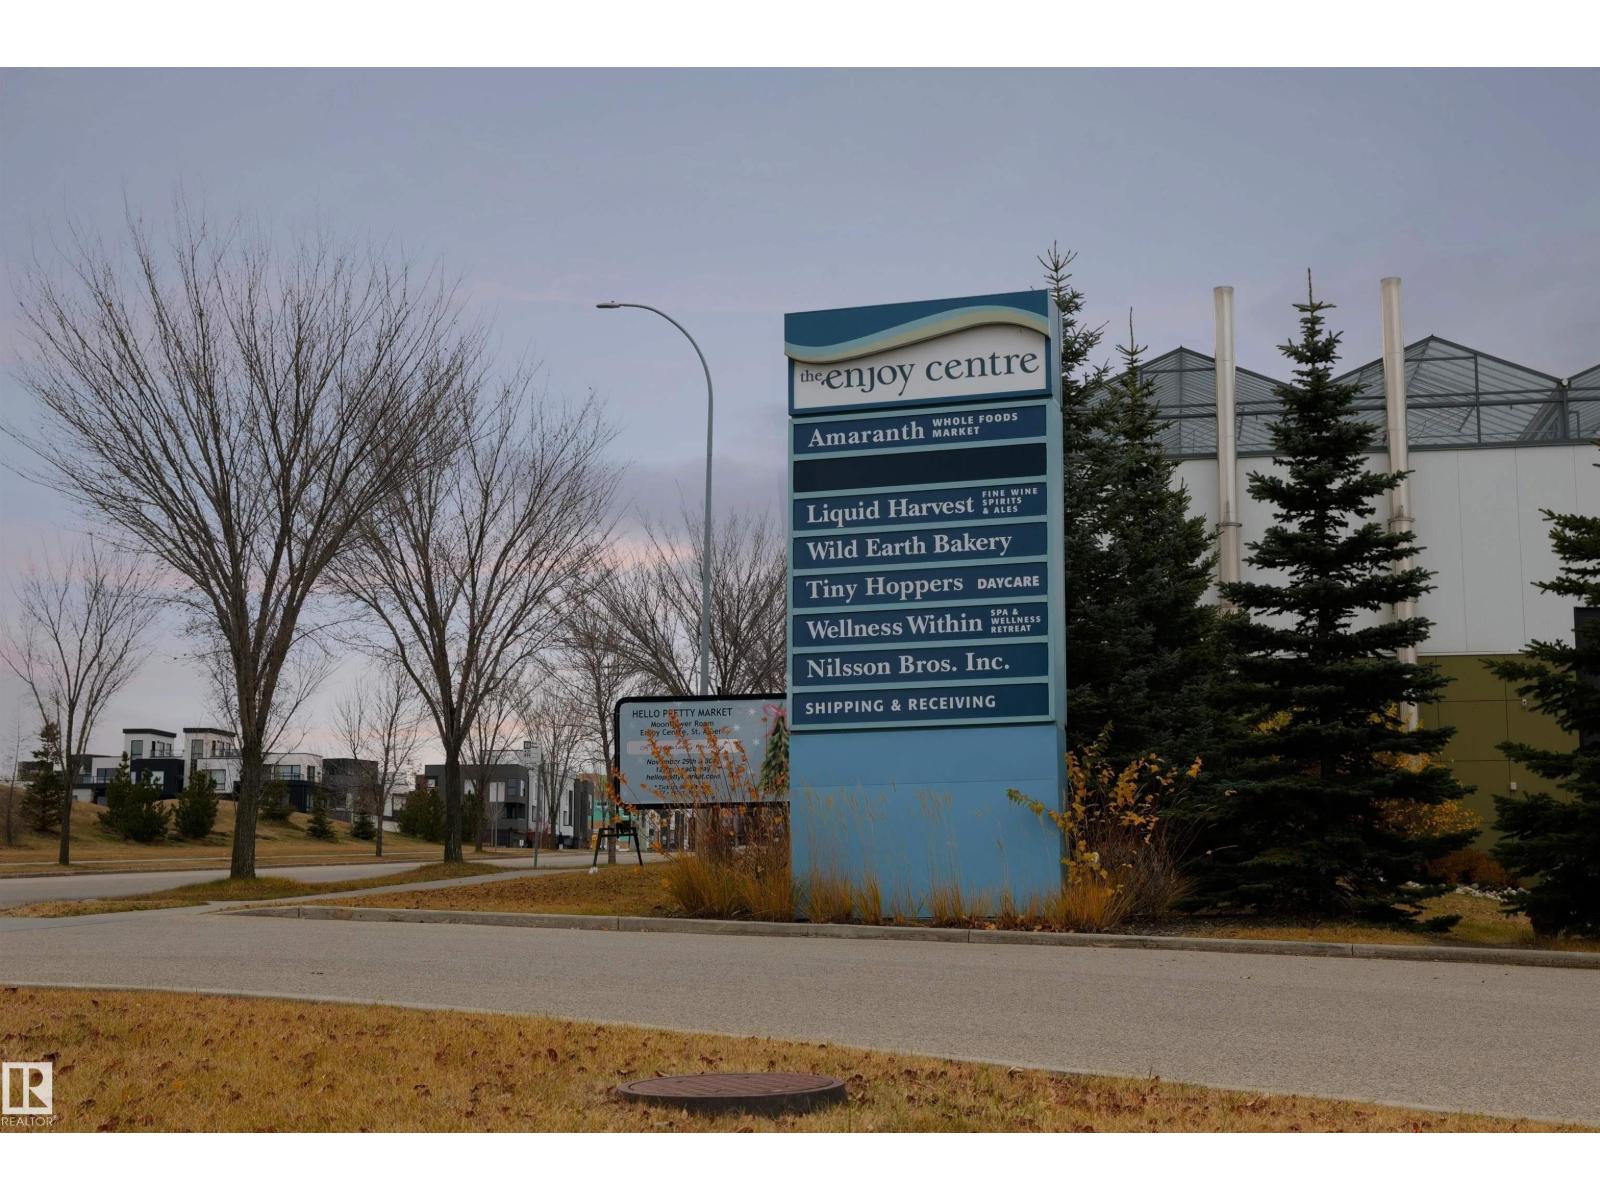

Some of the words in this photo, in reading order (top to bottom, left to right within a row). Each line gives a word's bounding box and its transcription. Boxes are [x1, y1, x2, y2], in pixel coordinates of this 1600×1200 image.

[800, 370, 822, 383] the
[821, 363, 917, 397] enjoy
[925, 351, 1040, 382] centre
[932, 416, 974, 428] WHOLE
[978, 412, 1018, 424] FOODS
[808, 420, 925, 448] Amaranth
[932, 426, 980, 438] MARKET
[982, 490, 1005, 498] FINE
[1010, 488, 1039, 496] WINE
[982, 497, 1022, 506] SPIRITS
[807, 501, 880, 528] Liquid
[888, 497, 974, 518] Harvest
[982, 507, 989, 515] &
[994, 505, 1018, 514] ALES
[806, 541, 858, 561] Wild
[865, 537, 927, 558] Earth
[933, 533, 1012, 556] Bakery
[806, 579, 858, 604] Tiny
[864, 576, 964, 601] Hoppers
[977, 575, 1040, 590] DAYCARE
[990, 609, 1009, 617] SPA
[1011, 608, 1019, 616] &
[991, 615, 1041, 625] WELLNESS
[806, 618, 903, 640] Wellness
[906, 613, 983, 634] Within
[991, 624, 1032, 634] RETREAT
[806, 658, 891, 679] Nilsson
[899, 654, 957, 674] Bros.
[965, 652, 1010, 672] Inc.
[805, 700, 884, 715] SHIPPING
[891, 699, 902, 712] &
[908, 695, 996, 711] RECEIVING
[632, 709, 660, 719] HELLO
[697, 707, 733, 717] MARKET
[650, 720, 692, 728] Moonwer
[662, 728, 689, 737] Cene,
[646, 758, 681, 766] Novmber
